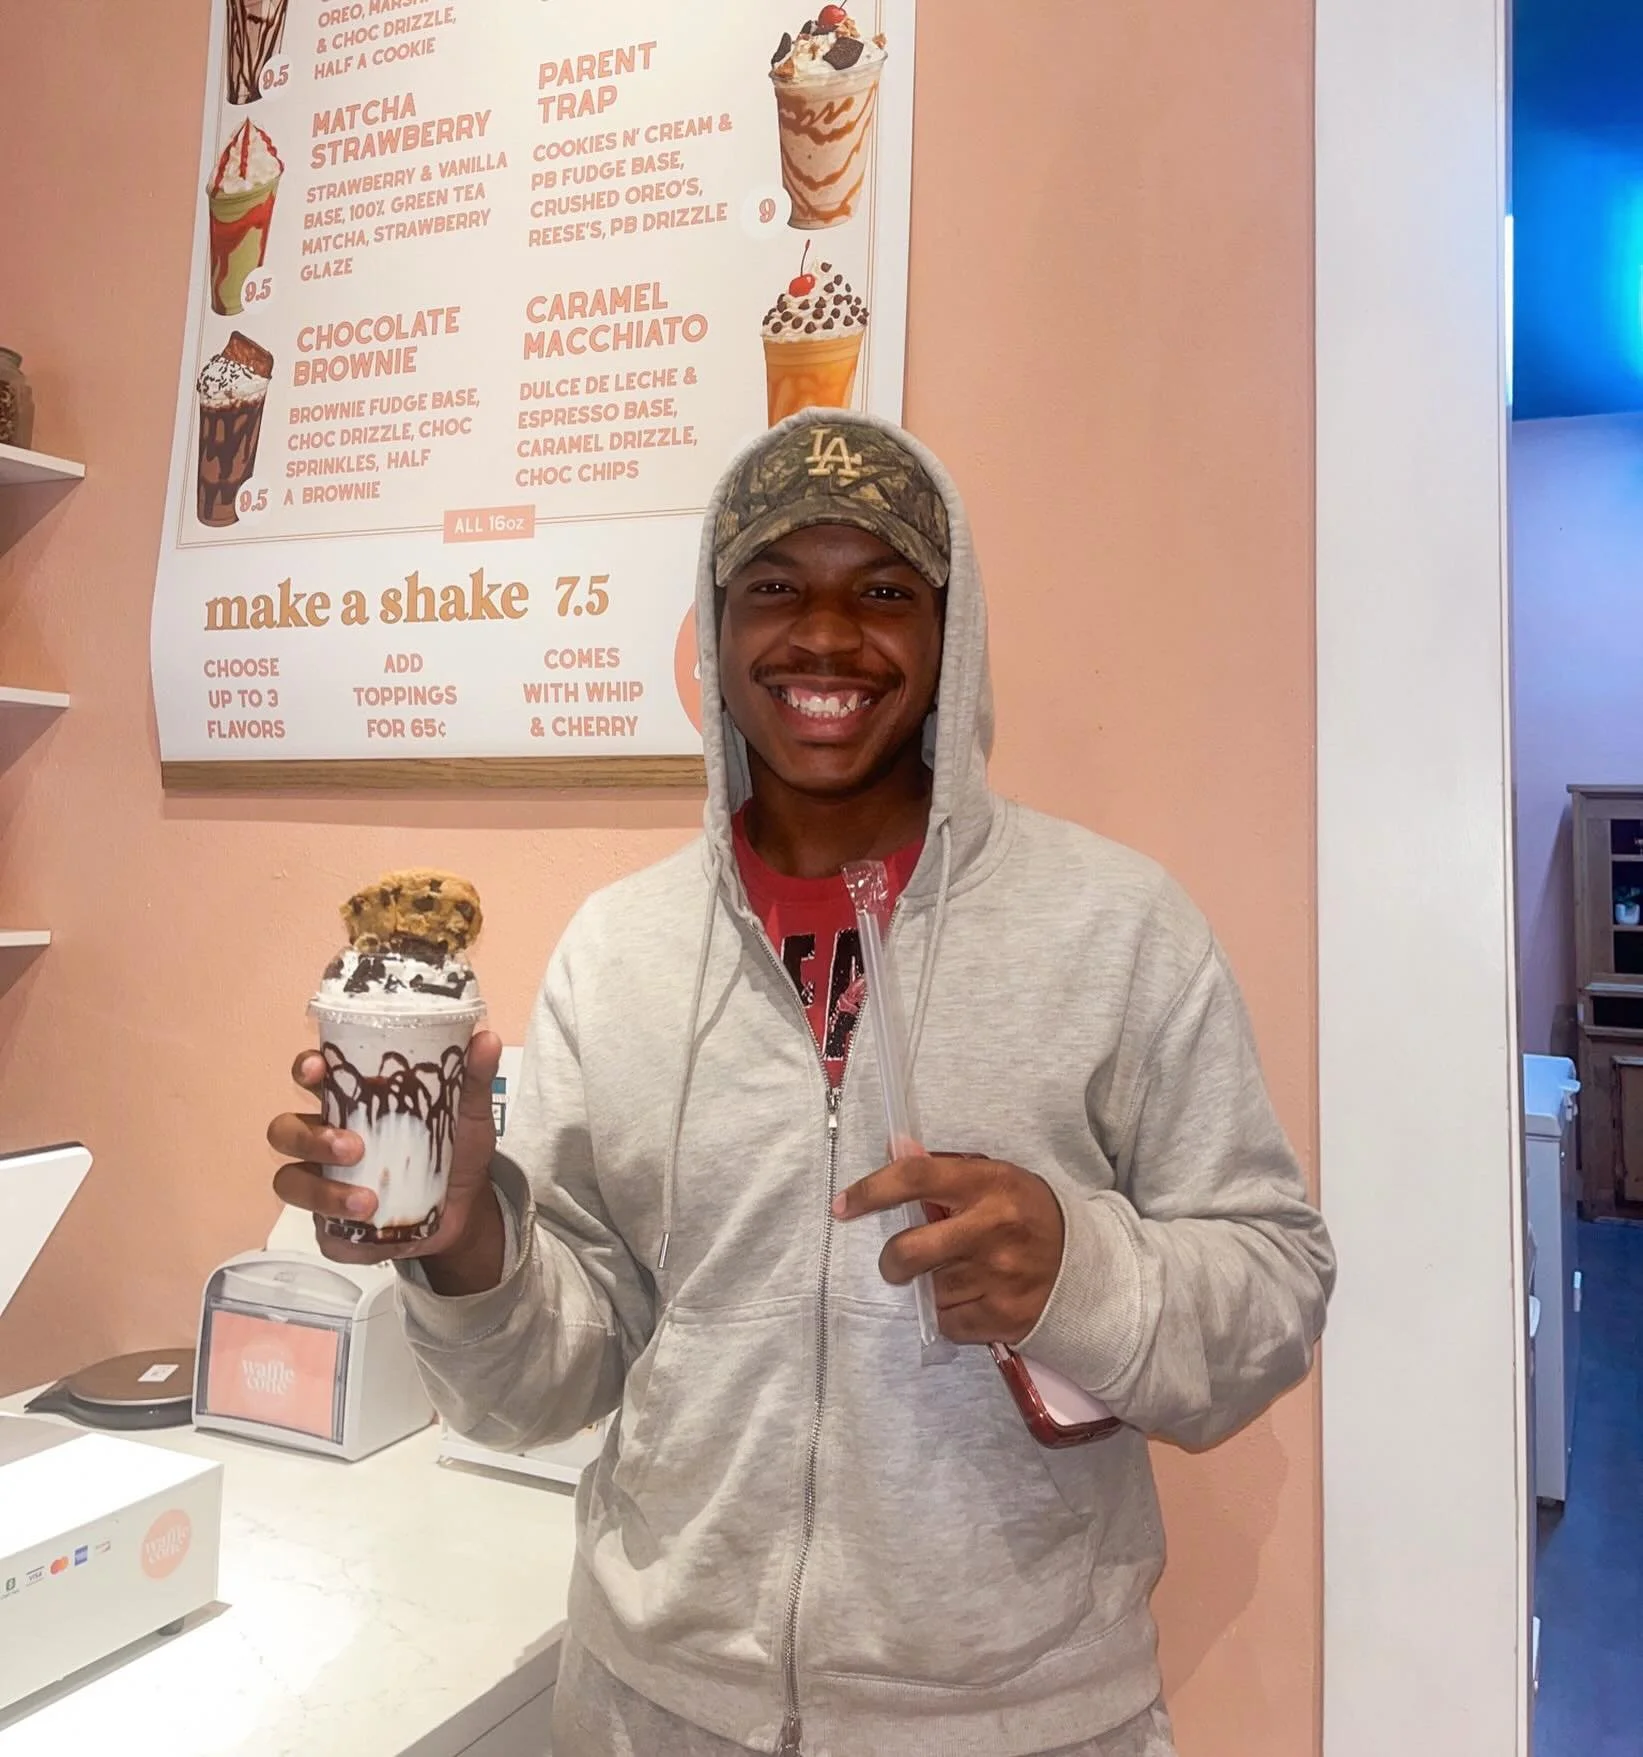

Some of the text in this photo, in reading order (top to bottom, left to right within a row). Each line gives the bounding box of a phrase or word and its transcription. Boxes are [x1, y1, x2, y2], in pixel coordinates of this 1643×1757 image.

[316, 7, 456, 54] & CHOC DRIZZLE,
[318, 3, 365, 28] OREO,
[314, 37, 436, 80] HALF A COOKIE
[538, 41, 657, 90] PARENT
[262, 64, 289, 90] 9.5
[312, 92, 416, 137] MATCHA
[537, 85, 618, 124] TRAP
[310, 110, 491, 169] STRAWBERRY
[533, 113, 733, 162] COOKIES N' CREAM &
[306, 152, 508, 203] STRAWBERRY & VANILLA
[531, 151, 684, 191] PB FUDGE BASE,
[304, 183, 485, 230] BASE, 100% GREEN TEA
[530, 177, 703, 219] CRUSHED OREO'S,
[758, 198, 776, 223] 9
[302, 208, 491, 256] MATCHA, STRAWBERRY
[528, 203, 728, 247] REESE'S, PB DRIZZLE
[300, 258, 353, 281] GLAZE
[244, 278, 272, 302] 9.5
[526, 281, 668, 324] CARAMEL
[297, 306, 461, 353] CHOCOLATE
[523, 314, 708, 360] MACCHIATO
[293, 346, 418, 387] BROWNIE
[519, 366, 698, 401] DULCE DE LECHE &
[289, 388, 480, 425] BROWNIE FUDGE BASE,
[518, 398, 678, 429] ESPRESSO BASE,
[288, 416, 472, 451] CHOC DRIZZLE, CHOC
[516, 426, 698, 458] CARAMEL DRIZZLE,
[286, 449, 431, 478] SPRINKLES, HALF
[805, 428, 863, 478] LA
[515, 460, 639, 487] CHOC CHIPS
[239, 488, 268, 513] 9.5
[283, 481, 381, 506] A BROWNIE
[454, 515, 525, 534] ALL 16oz
[204, 567, 610, 631] make a shake 7.5
[203, 658, 280, 678] CHOOSE
[384, 653, 424, 674] ADD
[543, 647, 620, 669] COMES
[208, 689, 279, 709] UP TO 3
[353, 685, 458, 707] TOPPINGS
[523, 680, 644, 704] WITH WHIP
[207, 719, 286, 739] FLAVORS
[367, 718, 447, 738] FOR 65¢
[530, 715, 638, 737] & CHERRY
